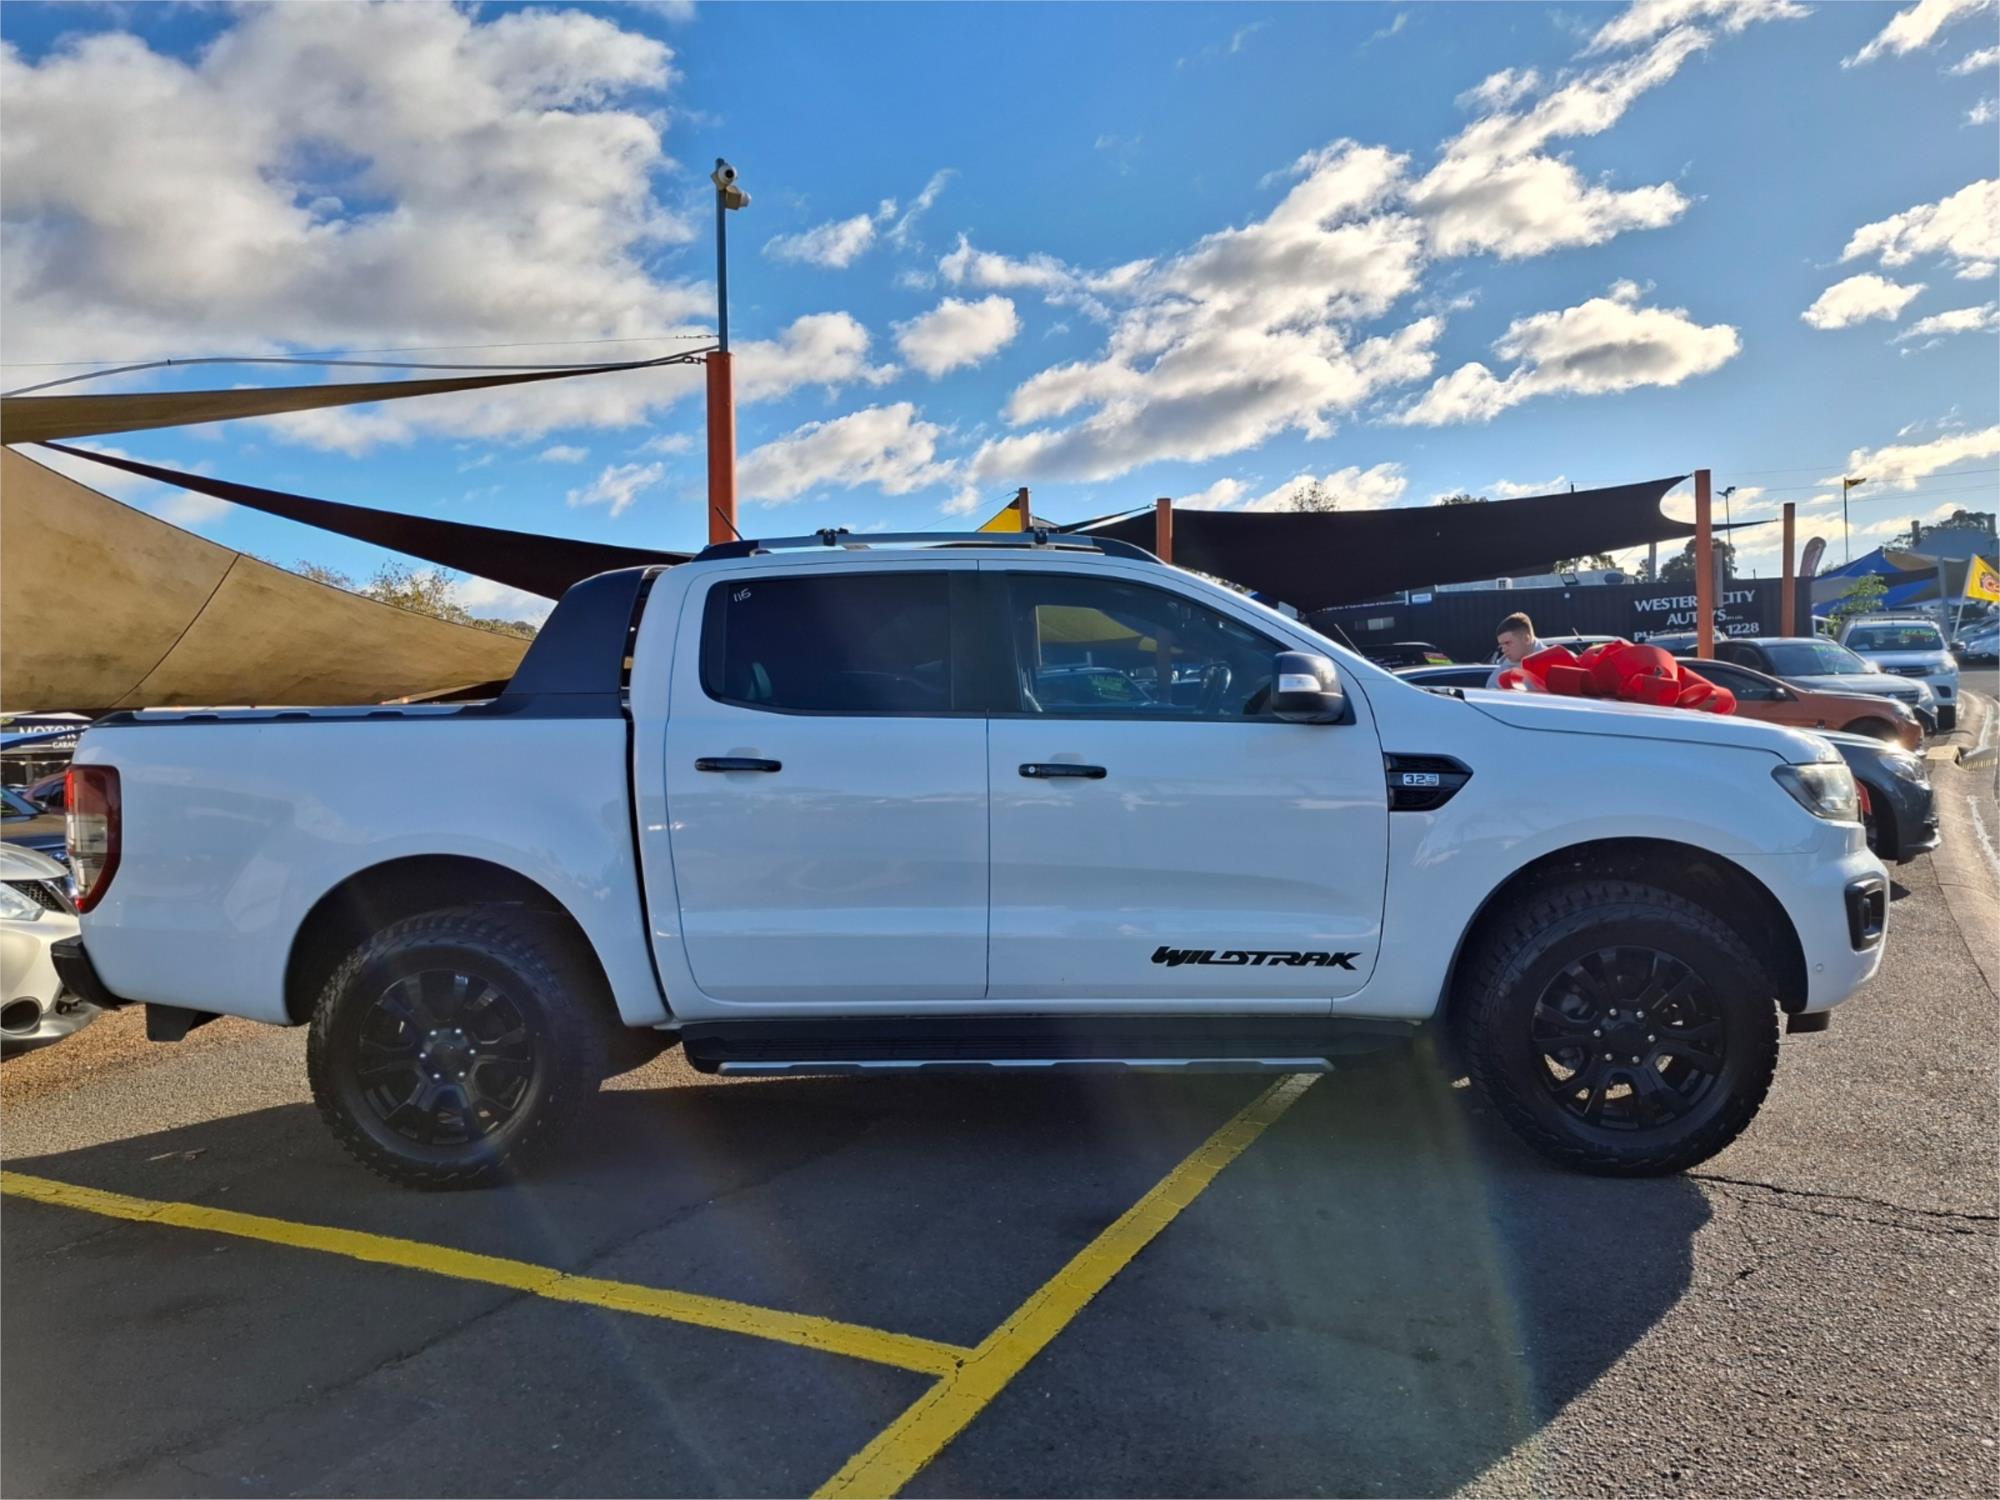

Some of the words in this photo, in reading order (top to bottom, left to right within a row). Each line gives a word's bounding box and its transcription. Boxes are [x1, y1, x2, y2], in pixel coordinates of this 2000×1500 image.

[1634, 595, 1698, 612] WESTER
[1726, 622, 1760, 635] 1228
[1151, 946, 1362, 970] WILDTRAK
